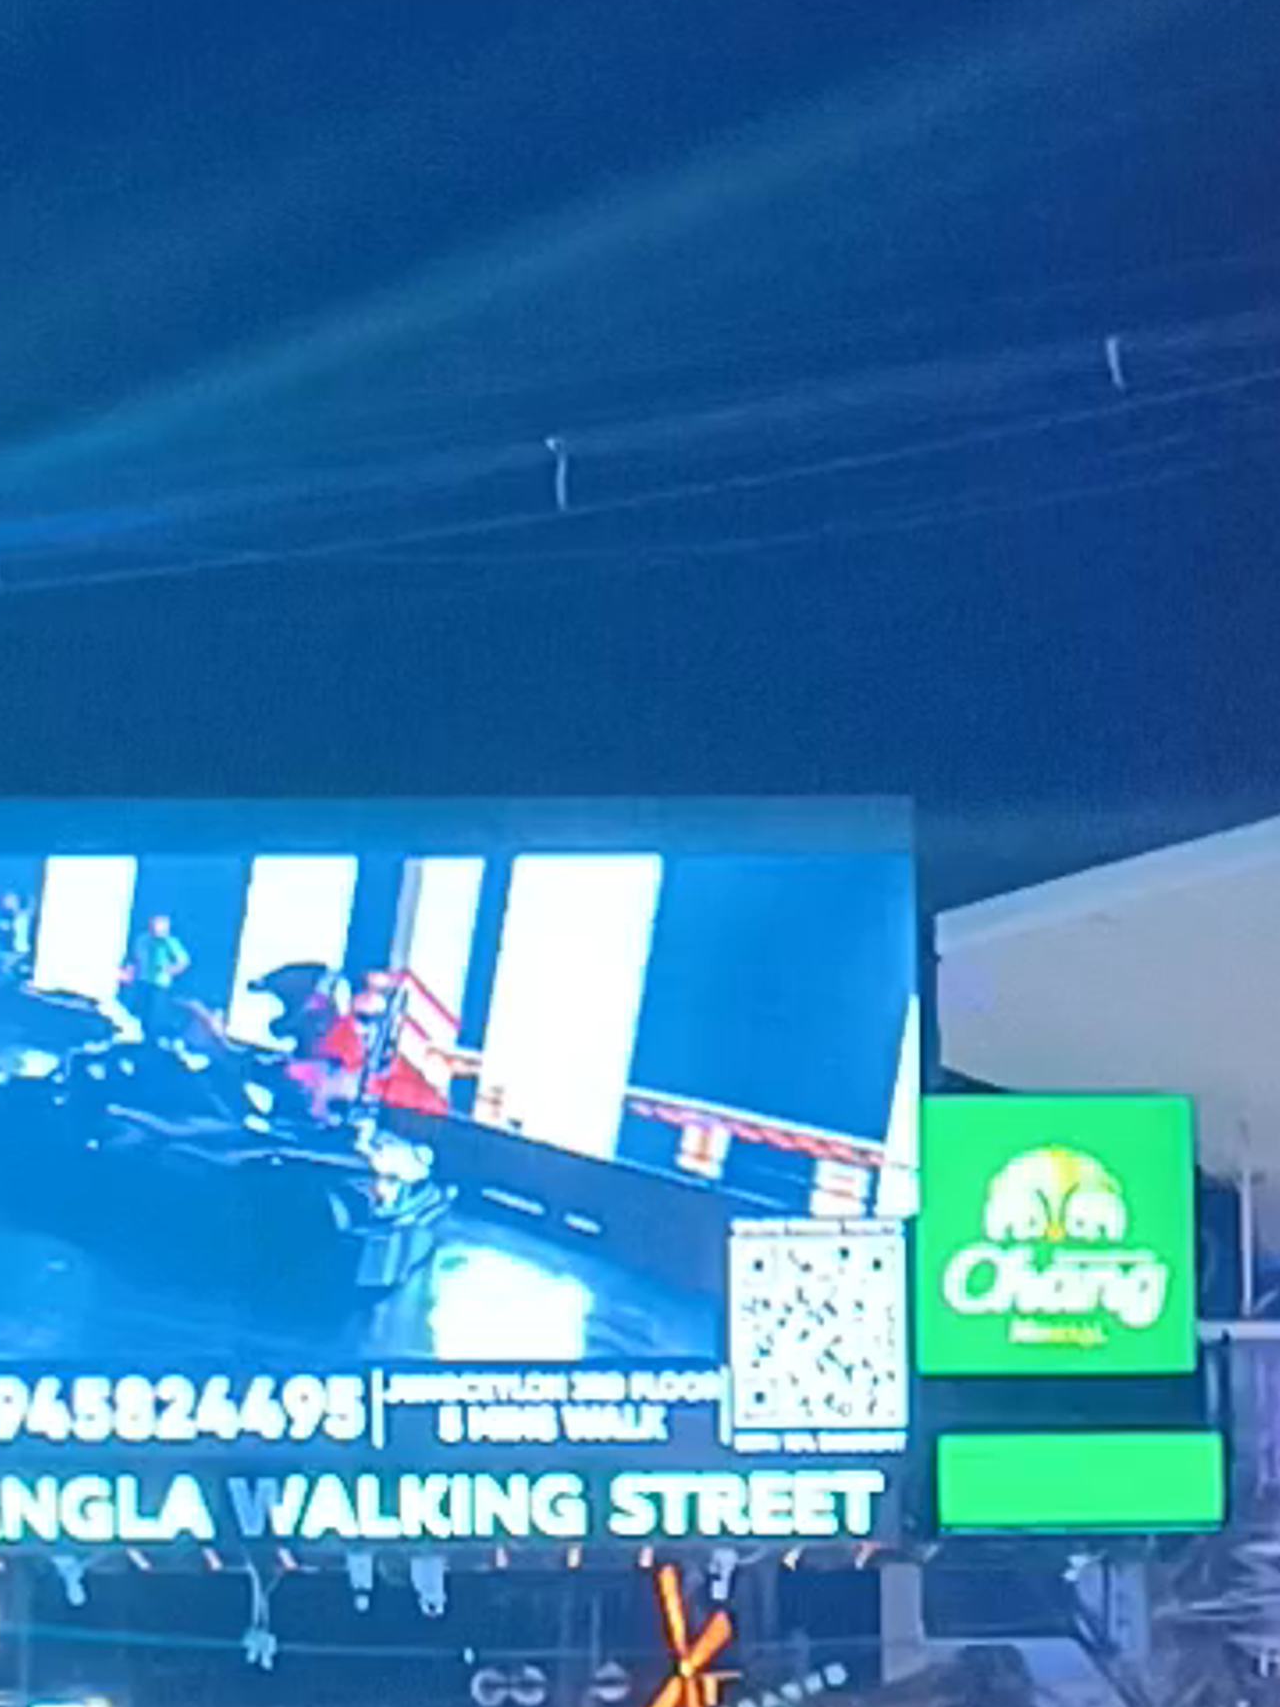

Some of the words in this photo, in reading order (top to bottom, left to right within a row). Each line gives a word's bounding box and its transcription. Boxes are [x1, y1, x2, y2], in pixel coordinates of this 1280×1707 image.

[939, 1241, 1169, 1330] Chang
[228, 1472, 587, 1539] WALKING
[609, 1469, 885, 1537] STREET
